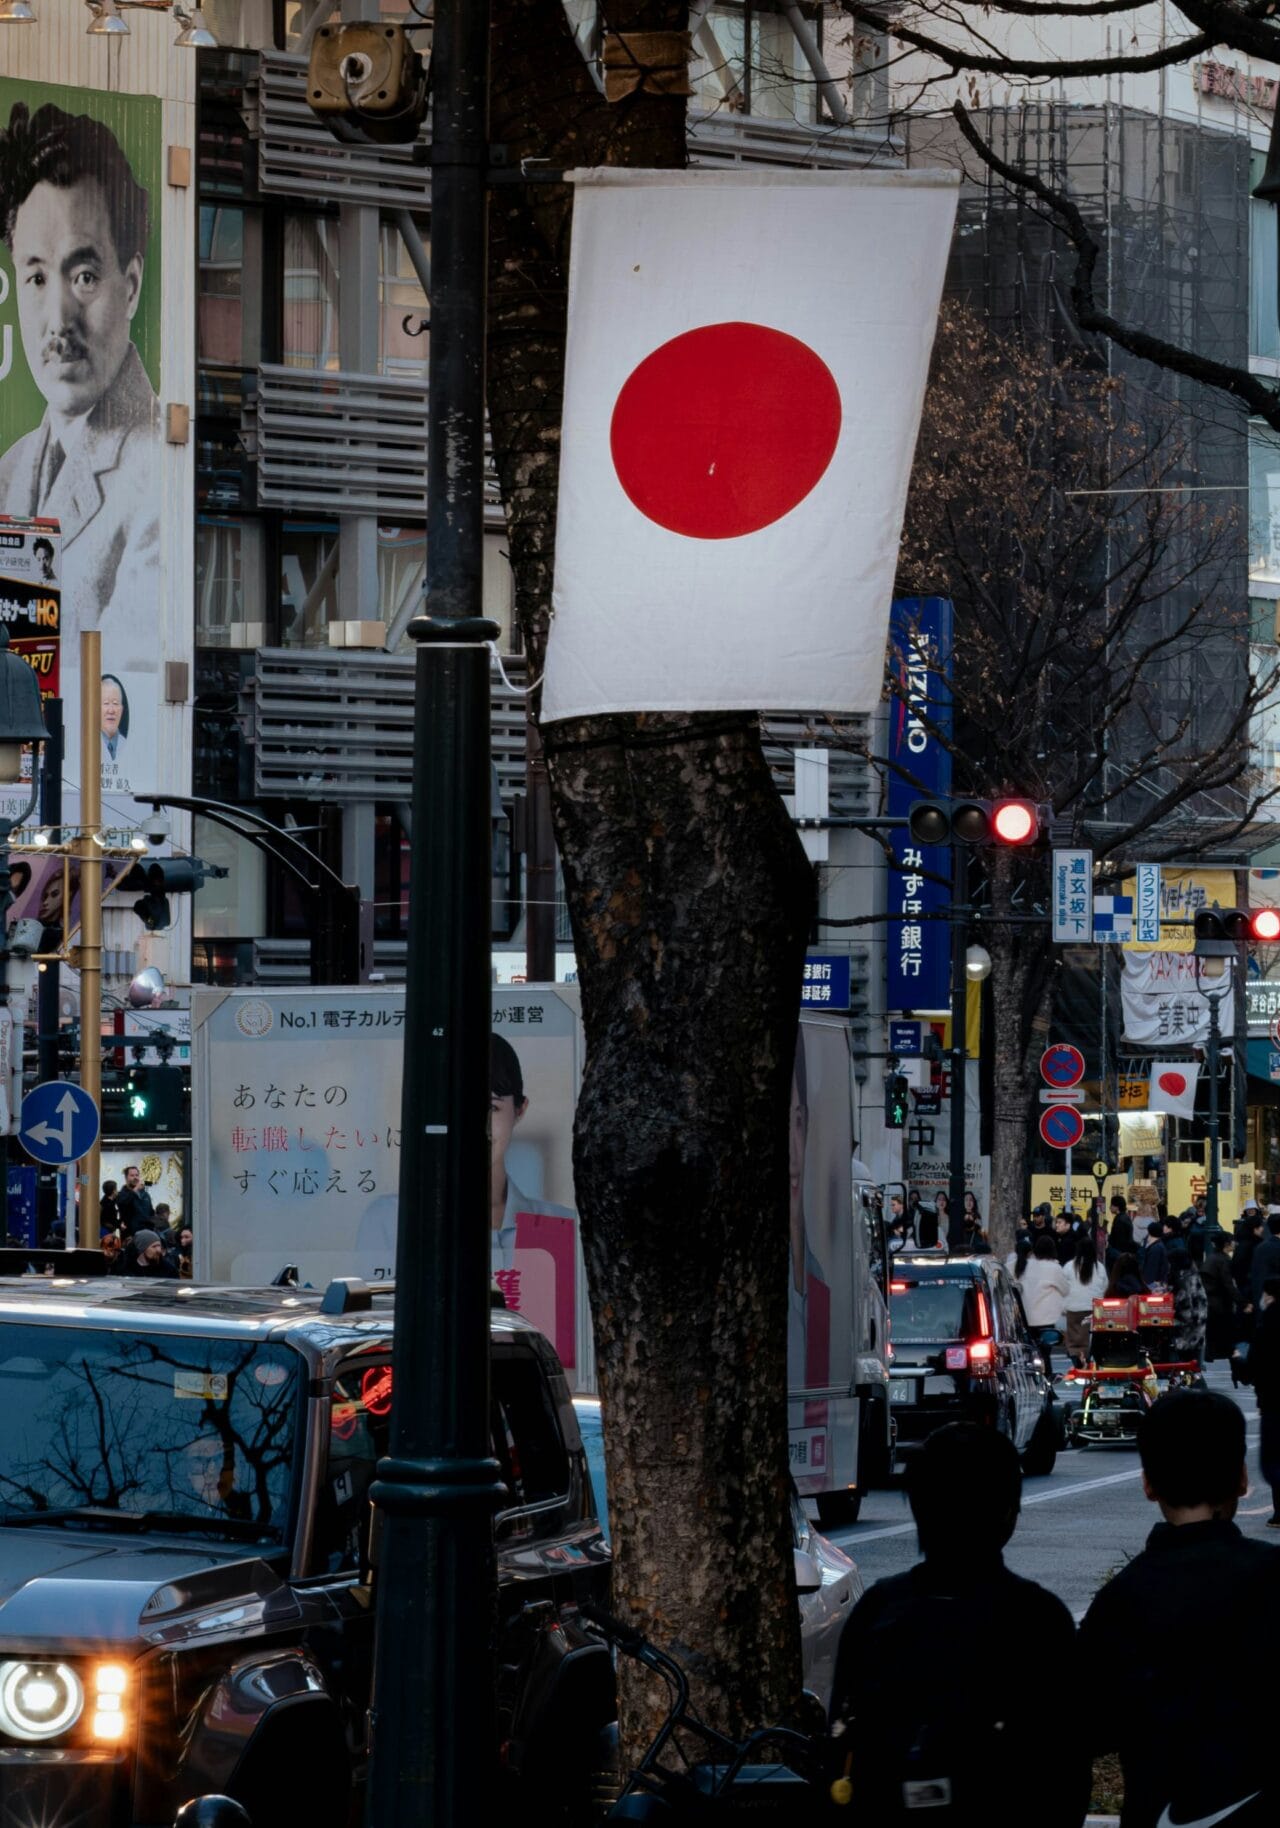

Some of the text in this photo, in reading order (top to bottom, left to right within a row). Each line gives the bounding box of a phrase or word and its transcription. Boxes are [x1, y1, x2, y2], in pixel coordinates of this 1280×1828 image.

[1071, 858, 1086, 935] 道玄坂下
[1143, 867, 1155, 941] スクランブル式
[900, 848, 925, 977] みずほ銀行
[280, 1011, 316, 1029] No.1
[1158, 1002, 1201, 1036] 営業中
[233, 1084, 348, 1109] あなたの
[231, 1126, 402, 1153] 転職したいに
[233, 1168, 377, 1195] すぐ応える
